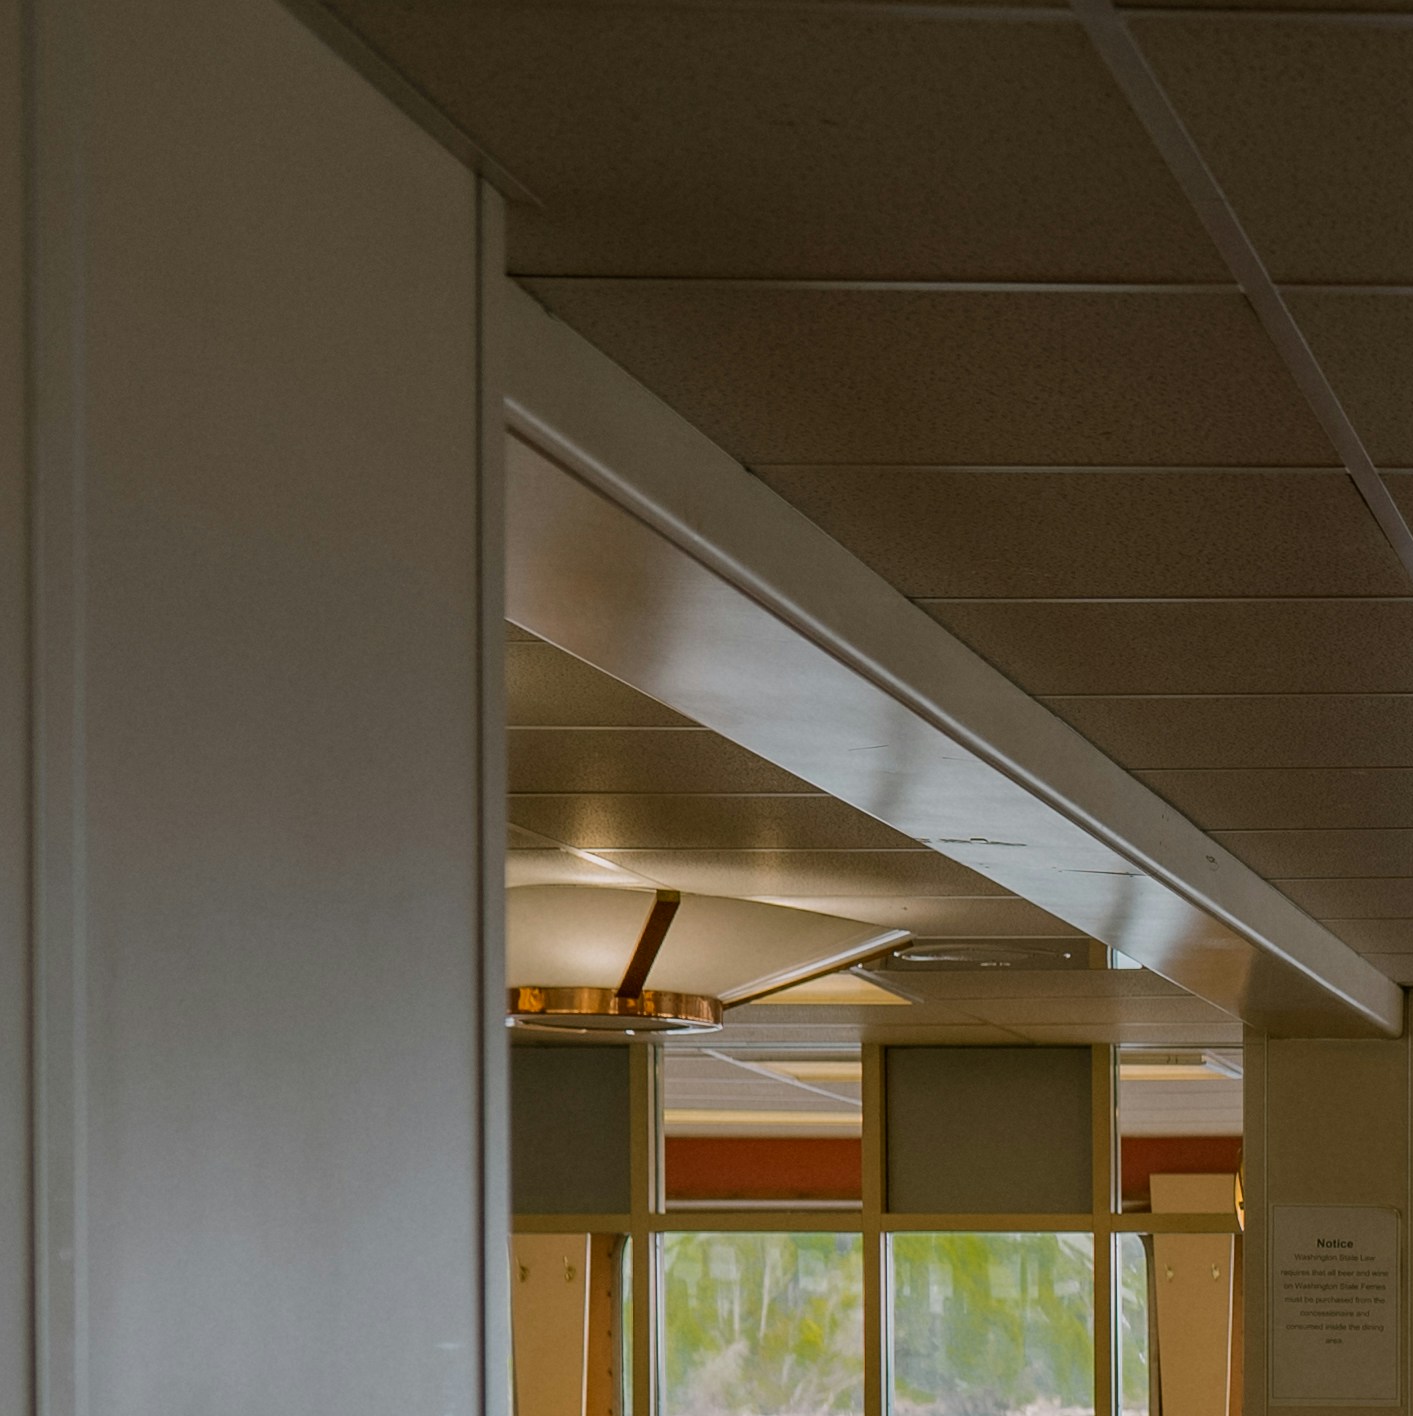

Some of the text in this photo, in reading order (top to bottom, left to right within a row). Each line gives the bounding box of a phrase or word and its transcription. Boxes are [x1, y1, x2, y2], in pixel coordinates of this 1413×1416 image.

[1316, 1238, 1354, 1249] Notice
[1294, 1253, 1376, 1262] Washington State Law
[1294, 1283, 1338, 1291] Washington
